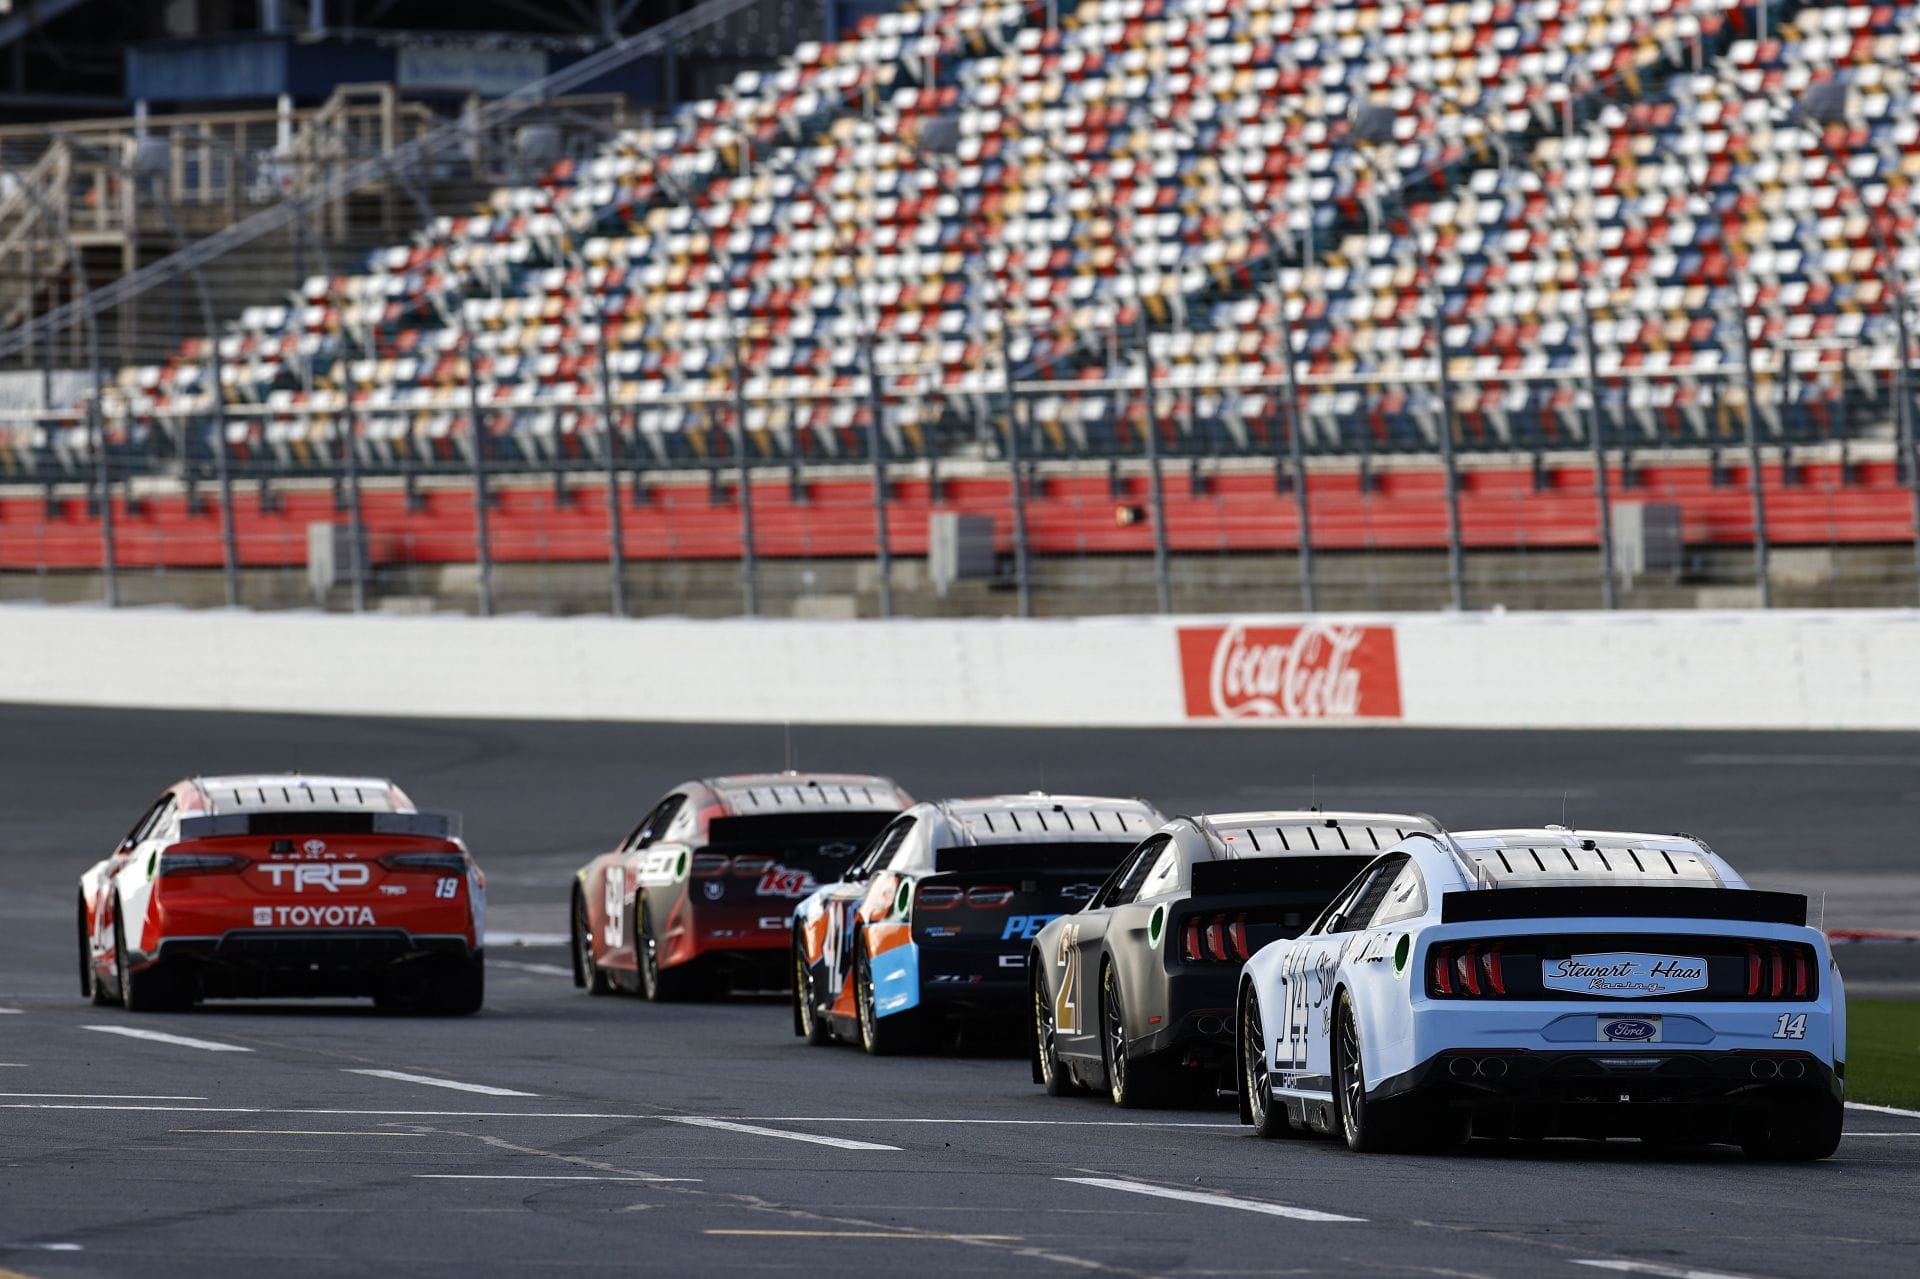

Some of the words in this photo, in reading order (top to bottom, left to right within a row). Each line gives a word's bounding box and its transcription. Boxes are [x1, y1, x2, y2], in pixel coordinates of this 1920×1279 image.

[257, 863, 369, 893] TRD
[436, 878, 459, 898] 19
[275, 906, 374, 926] TOYOTA
[1589, 979, 1665, 992] Racing
[1274, 943, 1309, 1069] 14
[1614, 1022, 1646, 1036] Ford
[1772, 1012, 1807, 1040] 14
